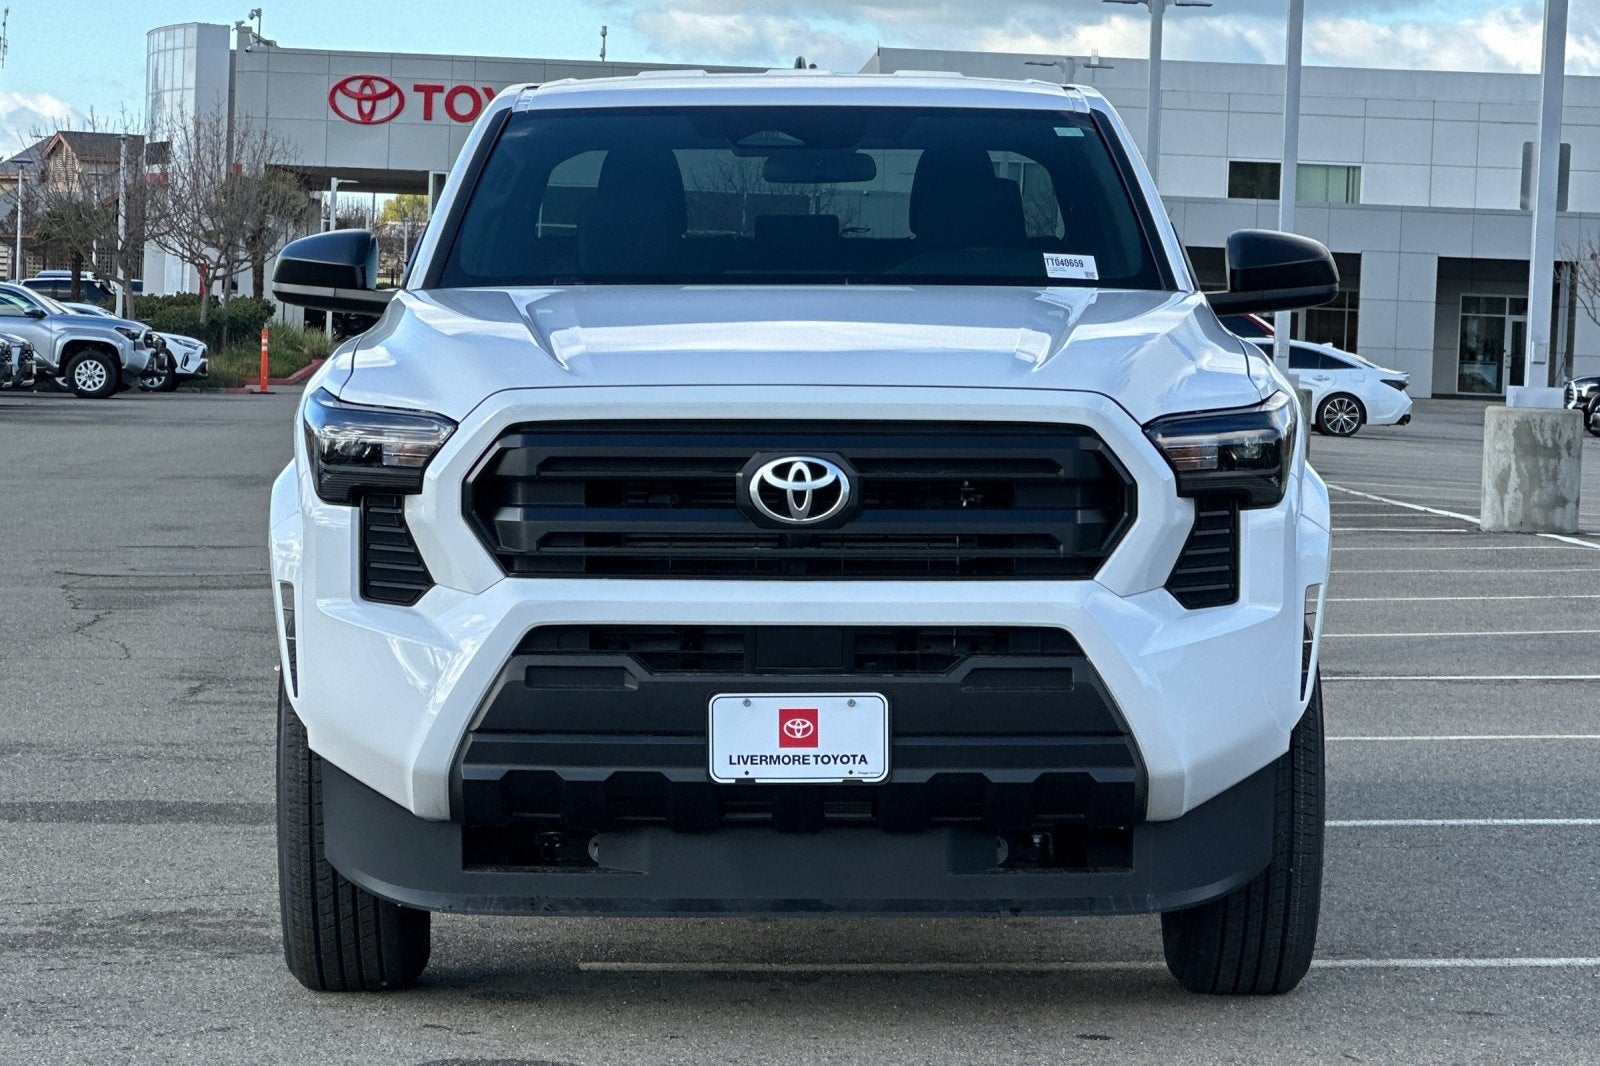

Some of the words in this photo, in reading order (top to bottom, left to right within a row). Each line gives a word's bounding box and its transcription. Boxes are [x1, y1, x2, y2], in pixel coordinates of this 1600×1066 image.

[1045, 257, 1084, 268] TT040659
[728, 754, 810, 766] LIVERMORE
[813, 754, 869, 766] TOYOTA
